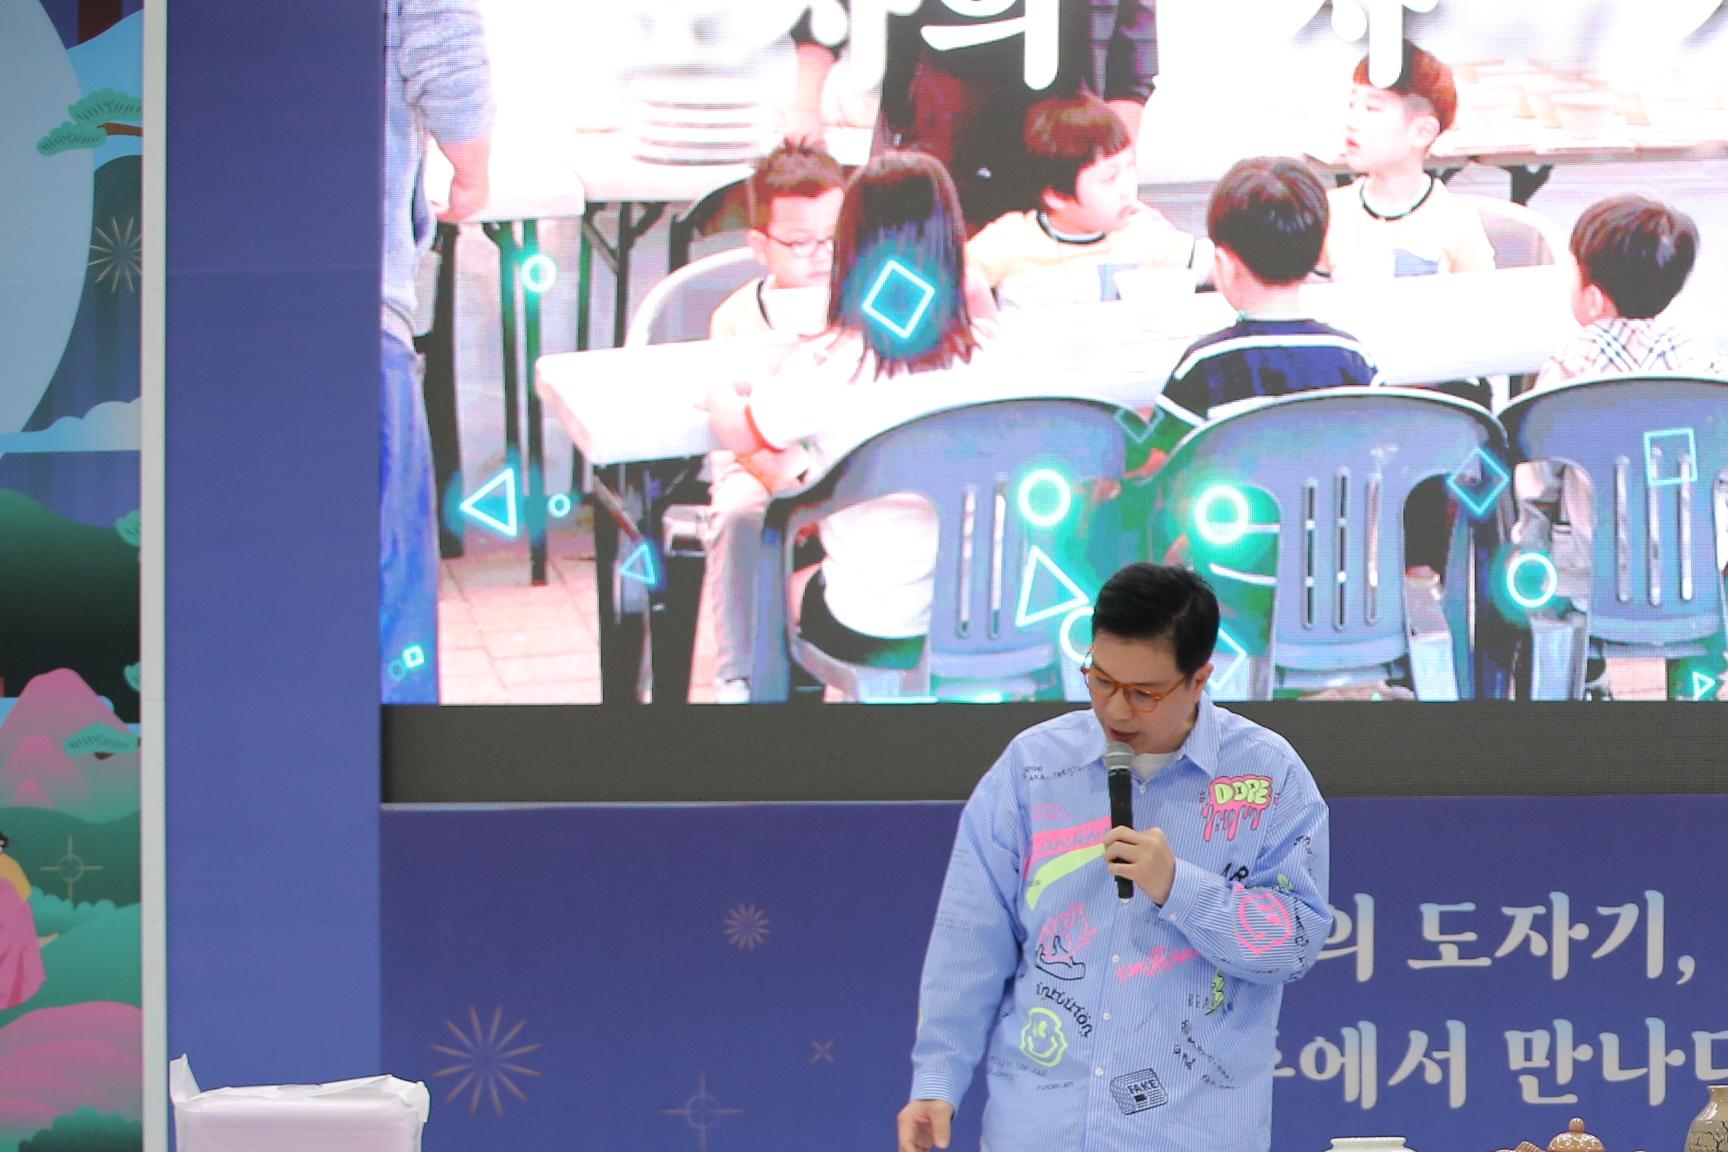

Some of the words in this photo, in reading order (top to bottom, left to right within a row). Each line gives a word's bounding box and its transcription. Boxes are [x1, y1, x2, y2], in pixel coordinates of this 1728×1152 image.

[1214, 778, 1271, 805] DOPE
[1407, 889, 1696, 986] 도자기,
[1127, 1079, 1159, 1095] FAKE
